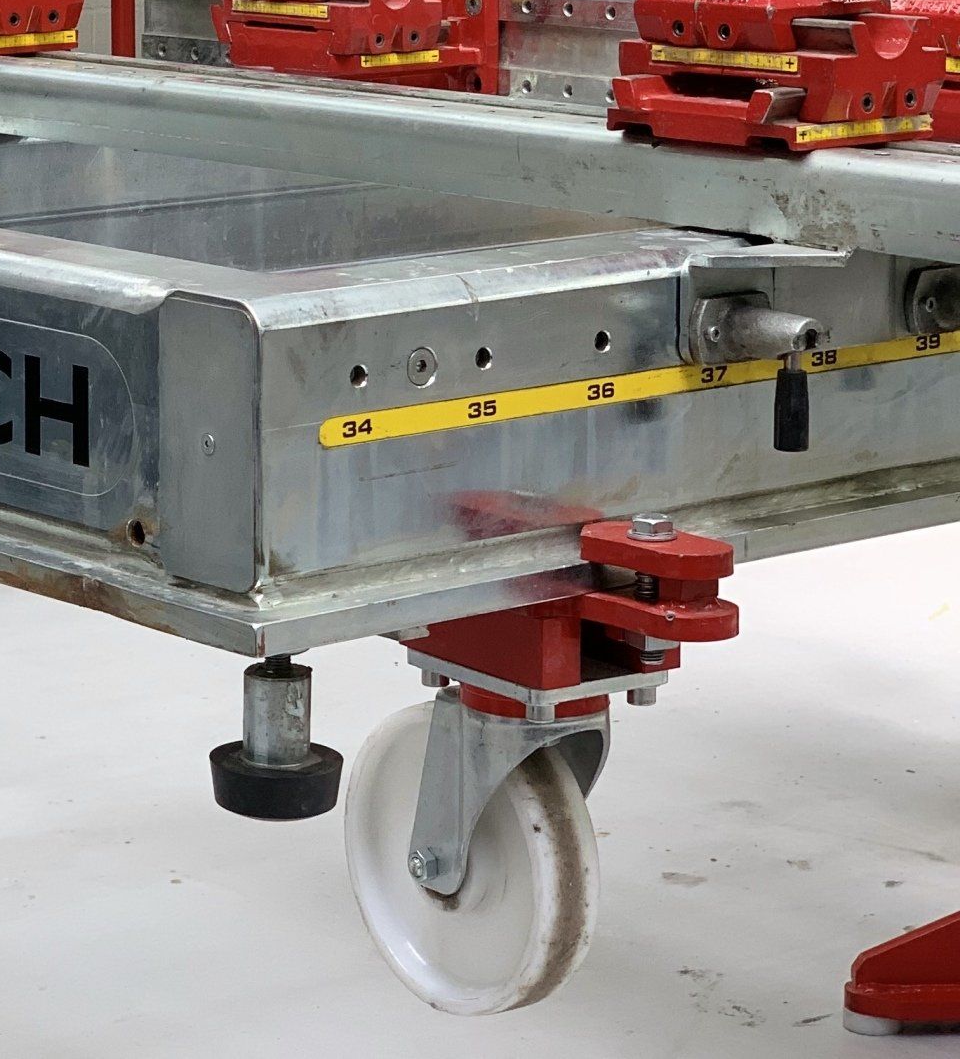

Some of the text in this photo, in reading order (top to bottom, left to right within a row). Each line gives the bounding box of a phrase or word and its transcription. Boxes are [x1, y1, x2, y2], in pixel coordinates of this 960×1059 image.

[342, 333, 940, 438] 34 35 36 37 38 39
